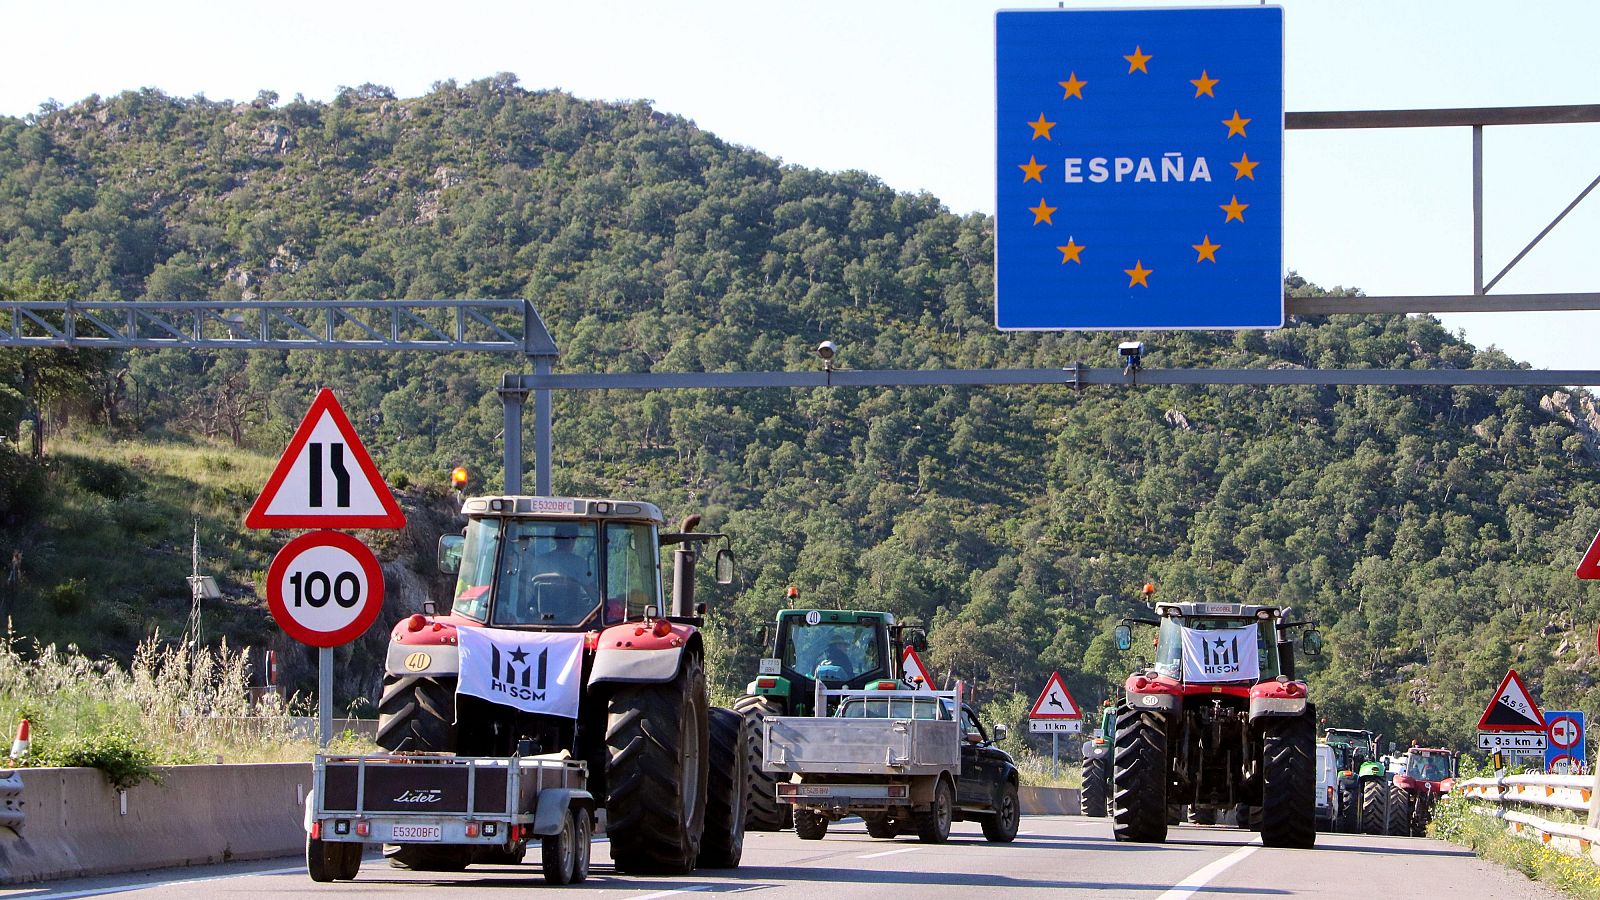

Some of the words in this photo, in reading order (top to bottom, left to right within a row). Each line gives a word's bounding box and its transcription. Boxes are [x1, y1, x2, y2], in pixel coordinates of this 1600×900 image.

[1064, 152, 1212, 183] ESPAÑA
[289, 571, 361, 608] 100
[408, 653, 426, 669] 40
[1204, 666, 1215, 674] HI
[1217, 665, 1239, 674] SOM
[491, 679, 506, 693] HI
[510, 686, 547, 701] SOM
[1145, 696, 1156, 705] 50
[1515, 737, 1531, 746] km
[393, 790, 442, 803] Lider
[393, 826, 440, 838] E5320BFC
